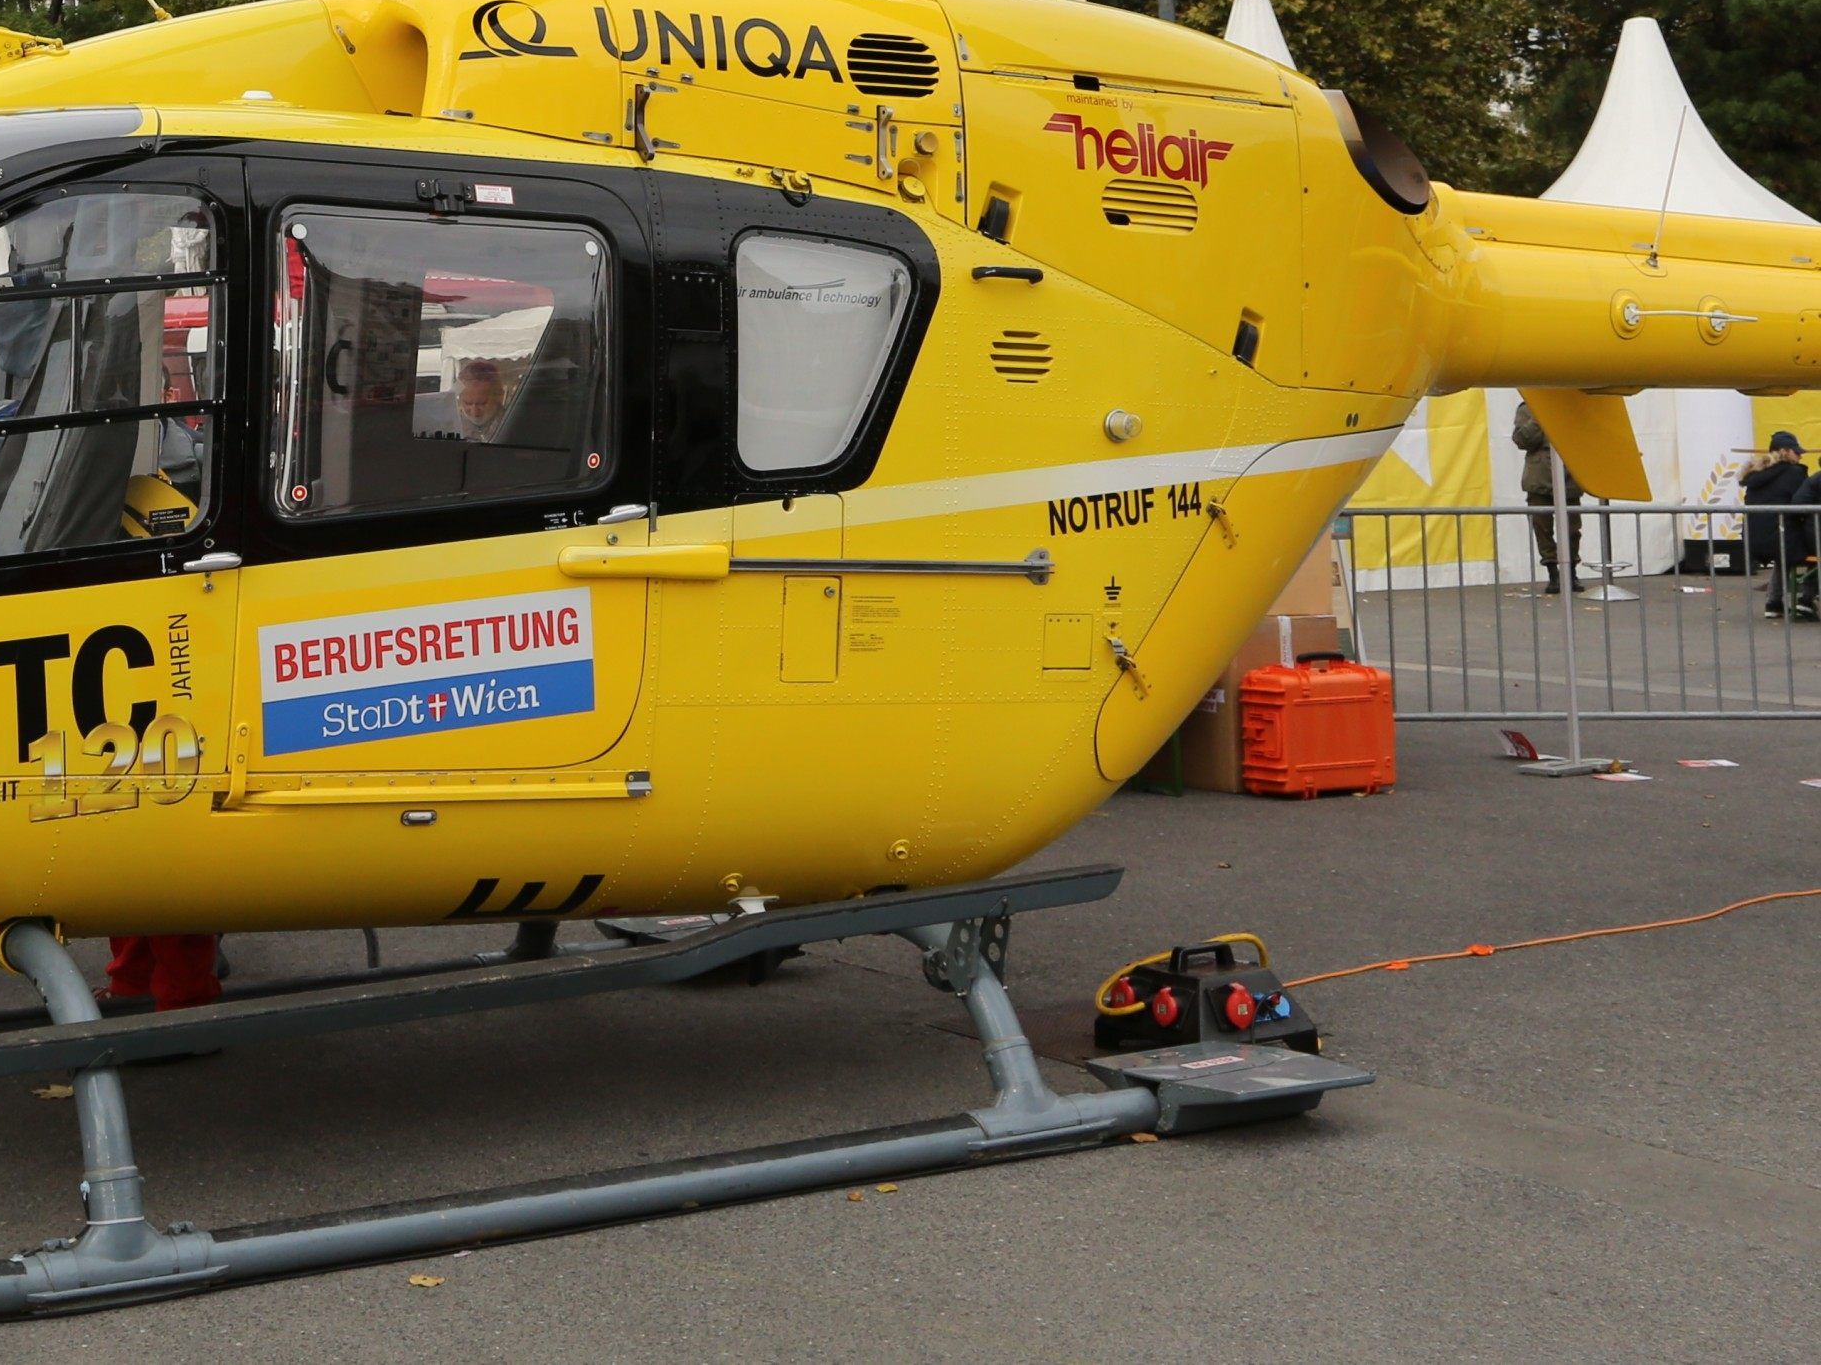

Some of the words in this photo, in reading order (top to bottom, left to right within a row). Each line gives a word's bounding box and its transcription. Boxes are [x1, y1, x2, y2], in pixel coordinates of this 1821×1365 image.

[593, 6, 844, 84] UNIQA
[1066, 93, 1118, 108] maintained
[1122, 98, 1134, 112] by
[1043, 113, 1235, 191] heliair
[734, 285, 747, 299] ir
[749, 286, 812, 302] ambulance
[816, 286, 882, 308] Technology
[1048, 487, 1155, 537] NOTRUF
[1167, 481, 1202, 520] 144
[167, 613, 193, 701] JAHREN
[274, 607, 580, 683] BERUFSRETTUNG
[450, 678, 540, 718] Wien
[26, 713, 201, 824] 120
